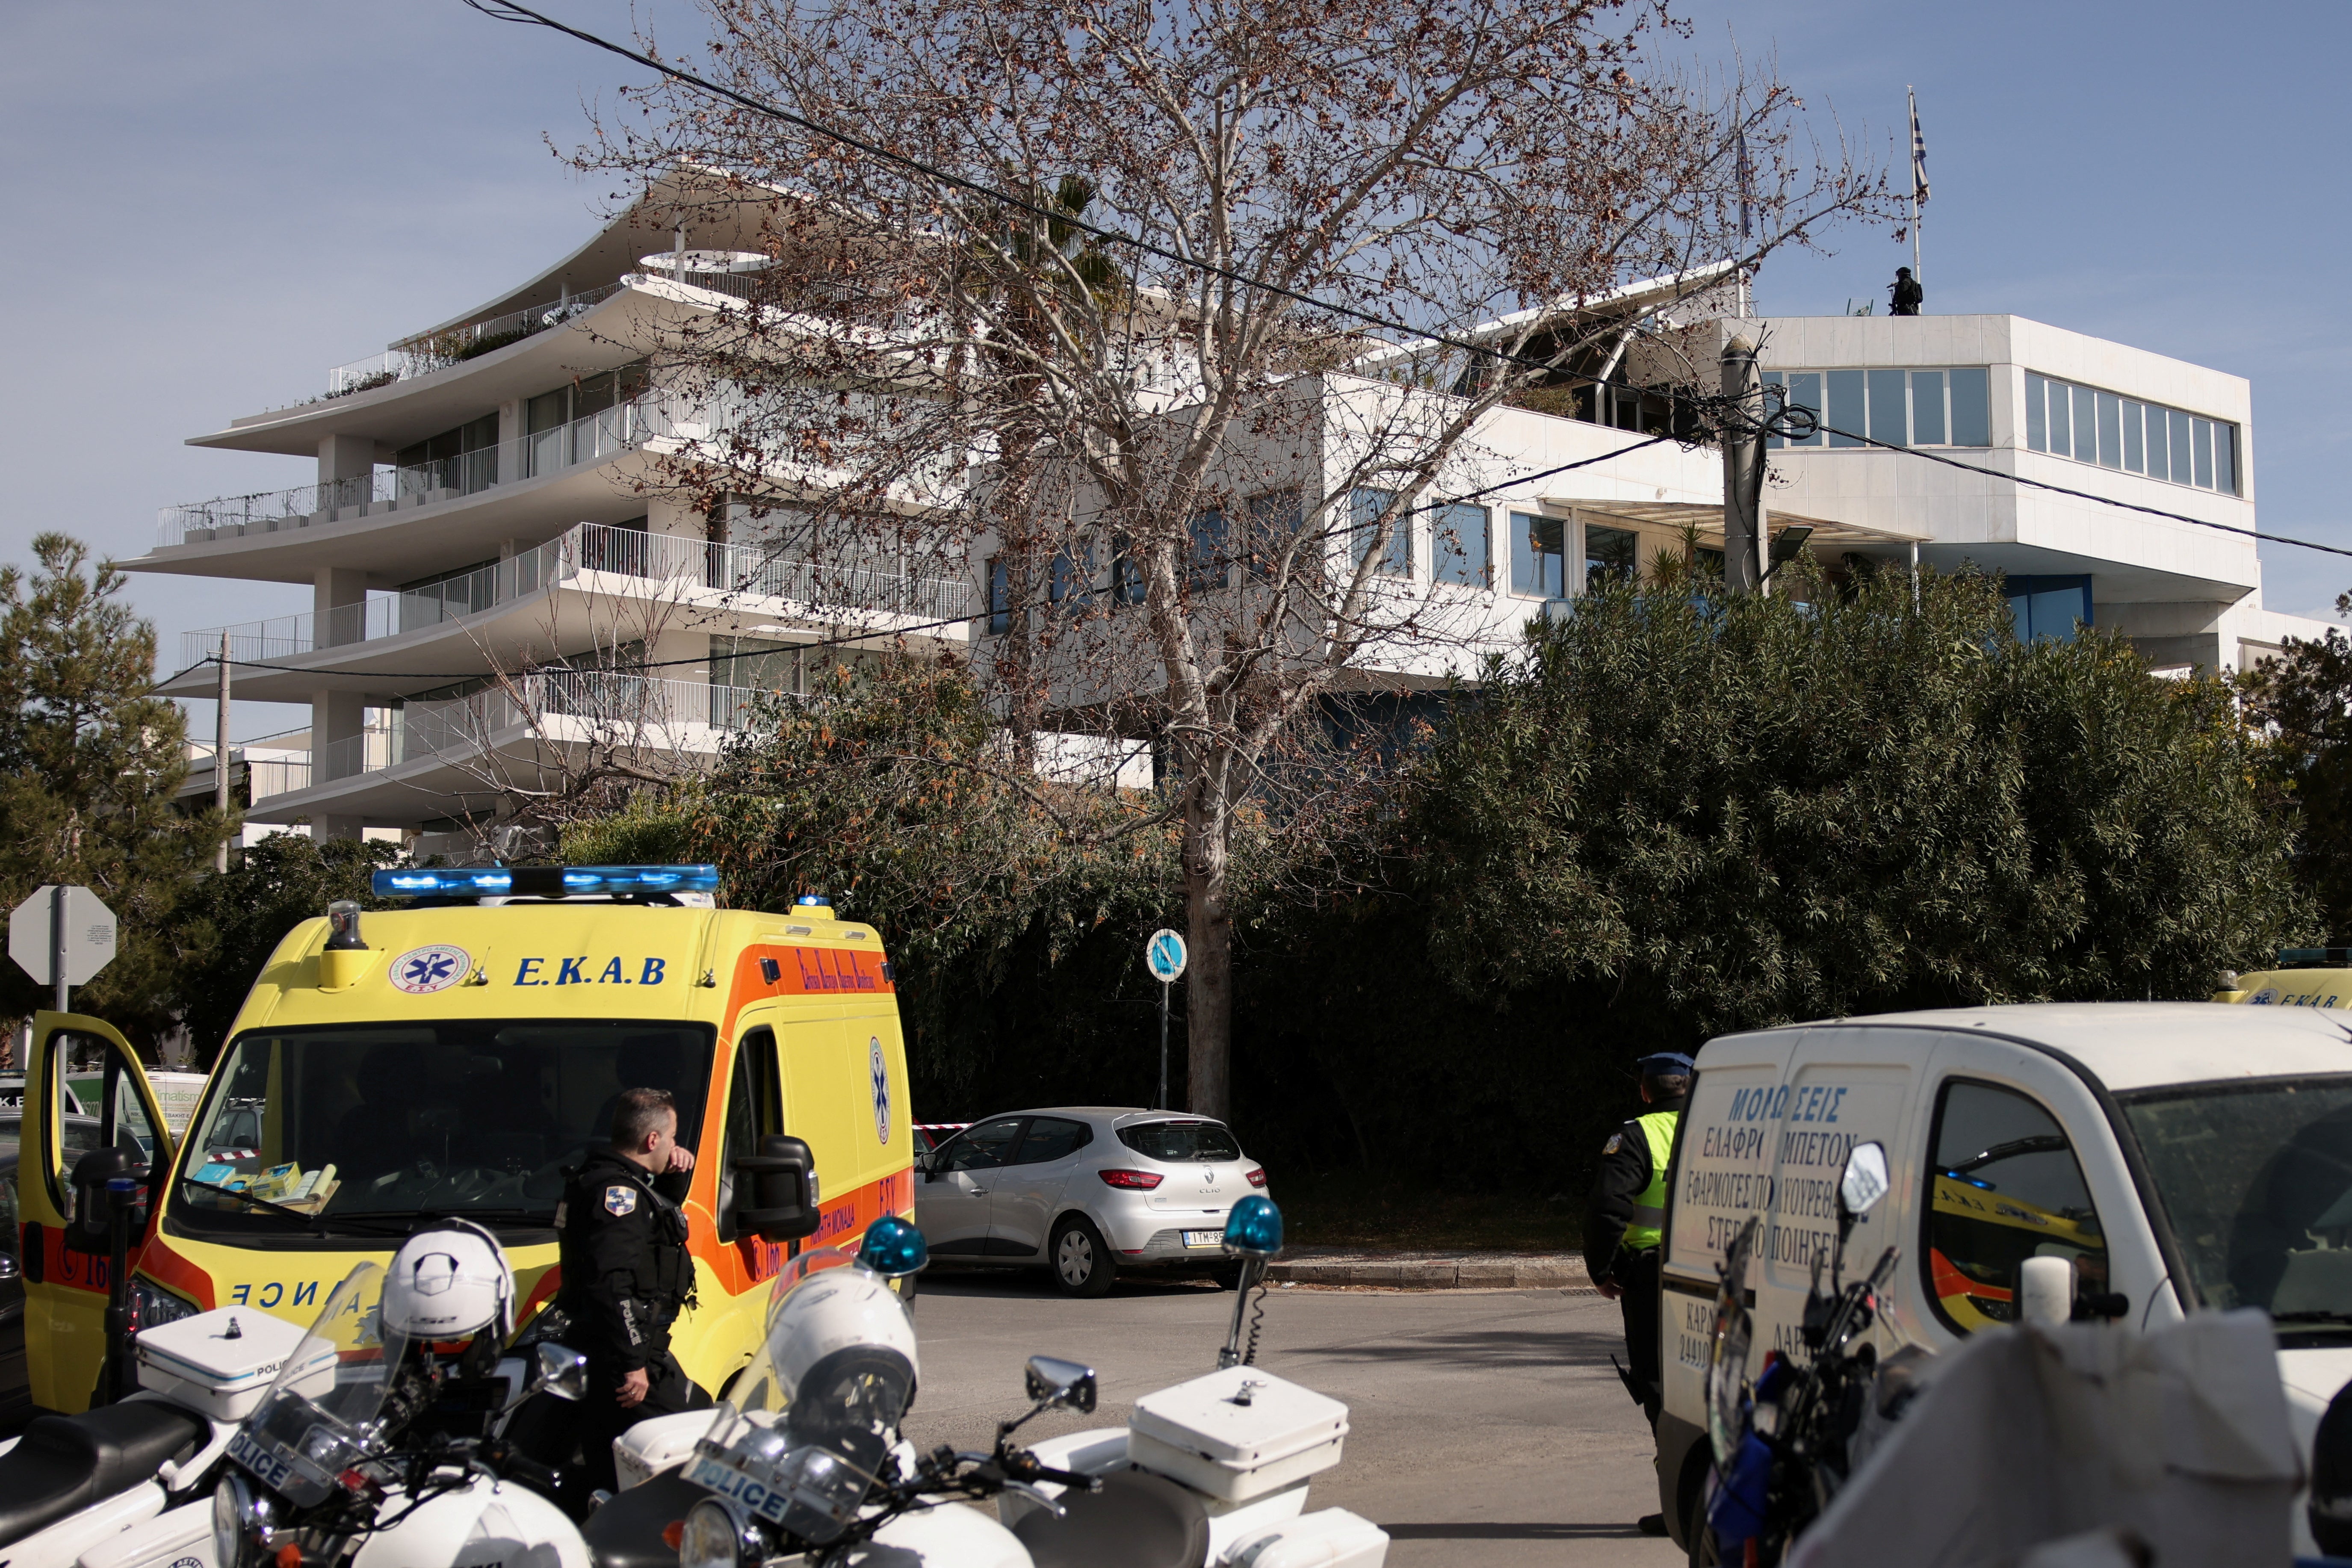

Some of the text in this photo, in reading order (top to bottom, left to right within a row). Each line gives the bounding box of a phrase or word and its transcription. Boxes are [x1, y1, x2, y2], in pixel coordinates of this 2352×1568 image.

[513, 957, 665, 986] Ε.Κ.Α.Β
[1686, 1170, 1752, 1209] ΕΦΑΡΜΟΓΕΣ
[85, 1254, 112, 1288] 16
[620, 1300, 641, 1346] POLICE
[691, 1459, 787, 1518] POLICE
